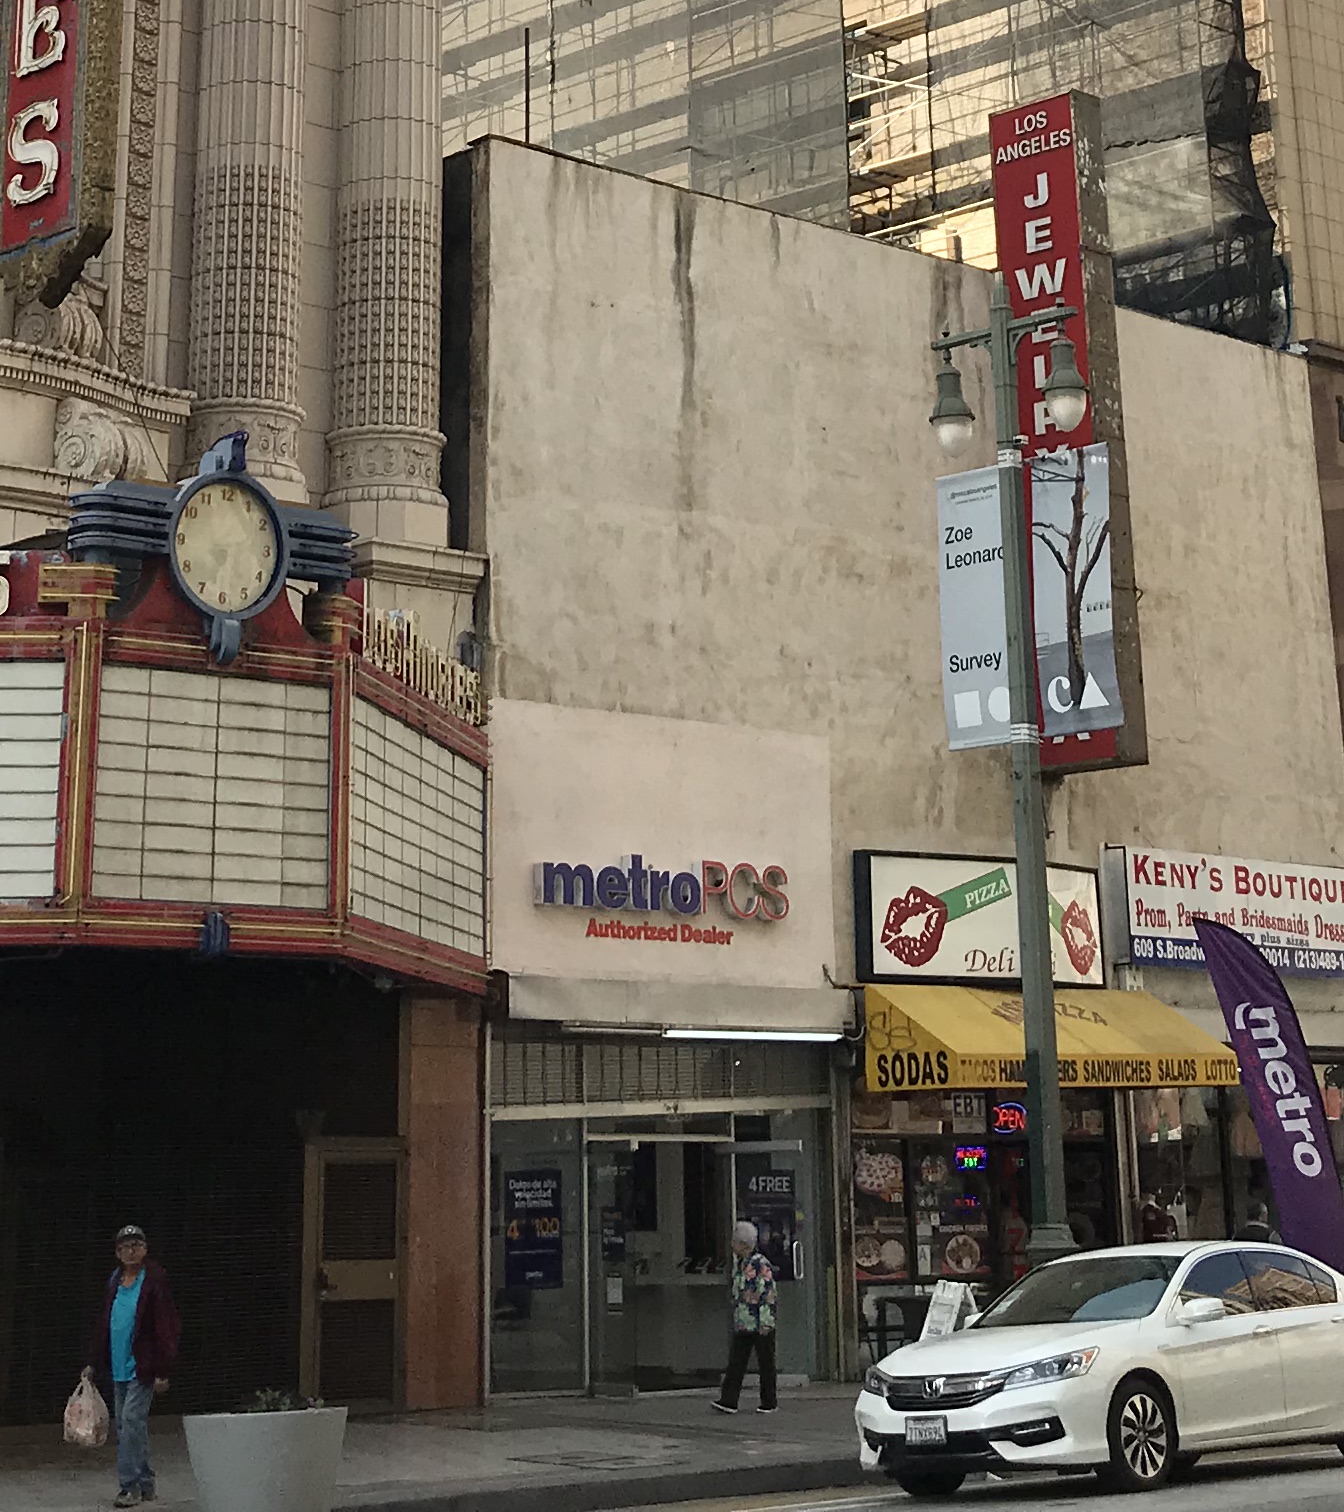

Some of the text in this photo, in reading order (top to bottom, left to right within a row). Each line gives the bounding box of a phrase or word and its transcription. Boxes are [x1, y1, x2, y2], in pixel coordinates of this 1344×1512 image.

[1014, 111, 1048, 135] LOS
[995, 129, 1071, 165] ANGELES
[1014, 172, 1070, 456] JEWE
[201, 493, 211, 505] 11
[221, 488, 234, 501] 12
[185, 506, 197, 519] 10
[246, 501, 251, 513] 1
[259, 519, 267, 531] 2
[944, 524, 974, 545] Zoe
[177, 533, 185, 545] 9
[263, 545, 270, 557] 3
[183, 560, 191, 572] 8
[255, 571, 262, 582] 4
[199, 582, 206, 593] 7
[219, 592, 226, 604] 6
[240, 588, 248, 600] 5
[949, 651, 1002, 674] Survey
[1132, 854, 1223, 892] KENY'S
[540, 853, 790, 920] metroPCS
[964, 879, 1009, 909] PIZZA
[1135, 898, 1172, 932] Prom,
[1214, 908, 1235, 927] and
[1241, 908, 1309, 936] Bridesmaids
[585, 918, 734, 945] Authorized Dealer
[1260, 932, 1281, 945] plus
[1286, 935, 1309, 947] sizes
[964, 947, 1016, 973] Deli
[1134, 938, 1153, 958] 609
[1156, 940, 1205, 961] S.Broadw
[1054, 1002, 1109, 1027] ZZA
[877, 1050, 949, 1087] SODAS
[999, 1059, 1078, 1083] HAMERS
[1083, 1060, 1152, 1083] SANDWICHES
[1157, 1059, 1198, 1083] SALADS
[1204, 1058, 1236, 1081] LOTTO
[1249, 1005, 1323, 1177] metro
[953, 1095, 984, 1117] EBT
[993, 1106, 1027, 1130] OPEN
